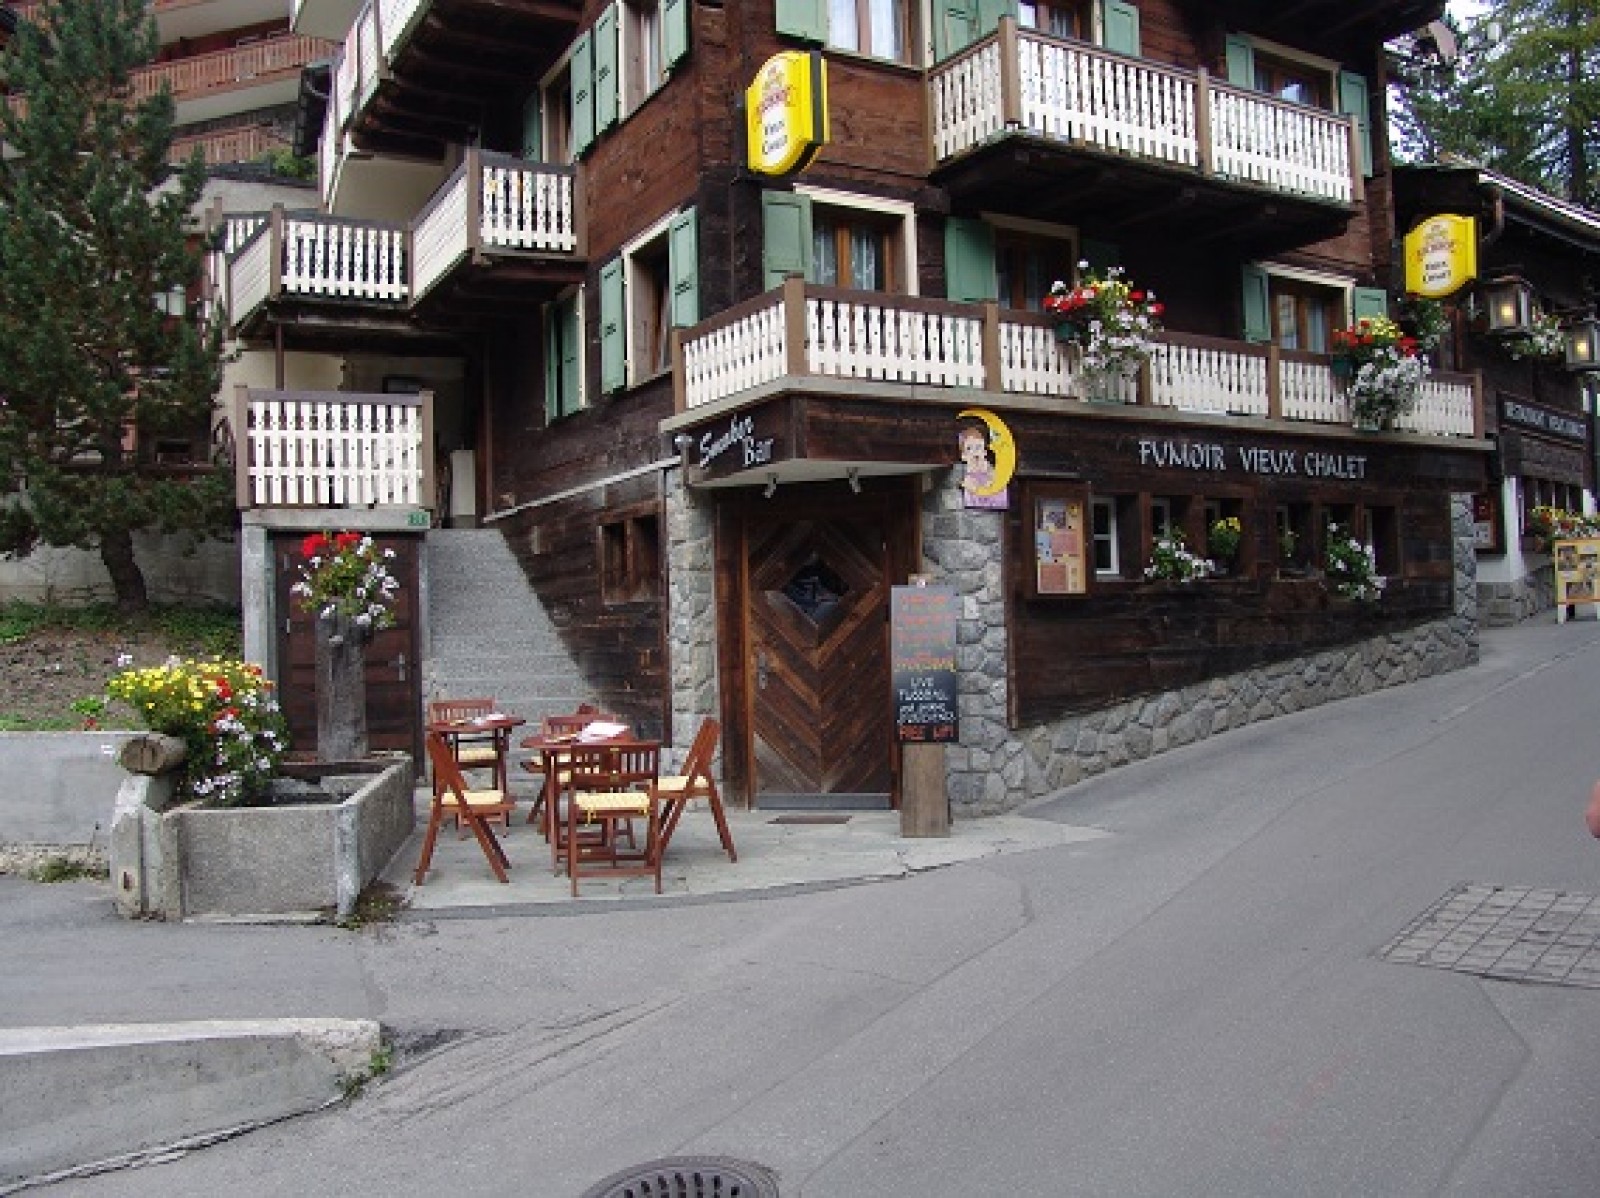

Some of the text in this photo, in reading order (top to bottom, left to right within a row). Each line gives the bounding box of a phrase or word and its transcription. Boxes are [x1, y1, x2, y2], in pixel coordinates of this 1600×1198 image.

[742, 437, 774, 467] Bar
[1239, 445, 1297, 473] VIEUX
[1304, 451, 1367, 478] CHALET
